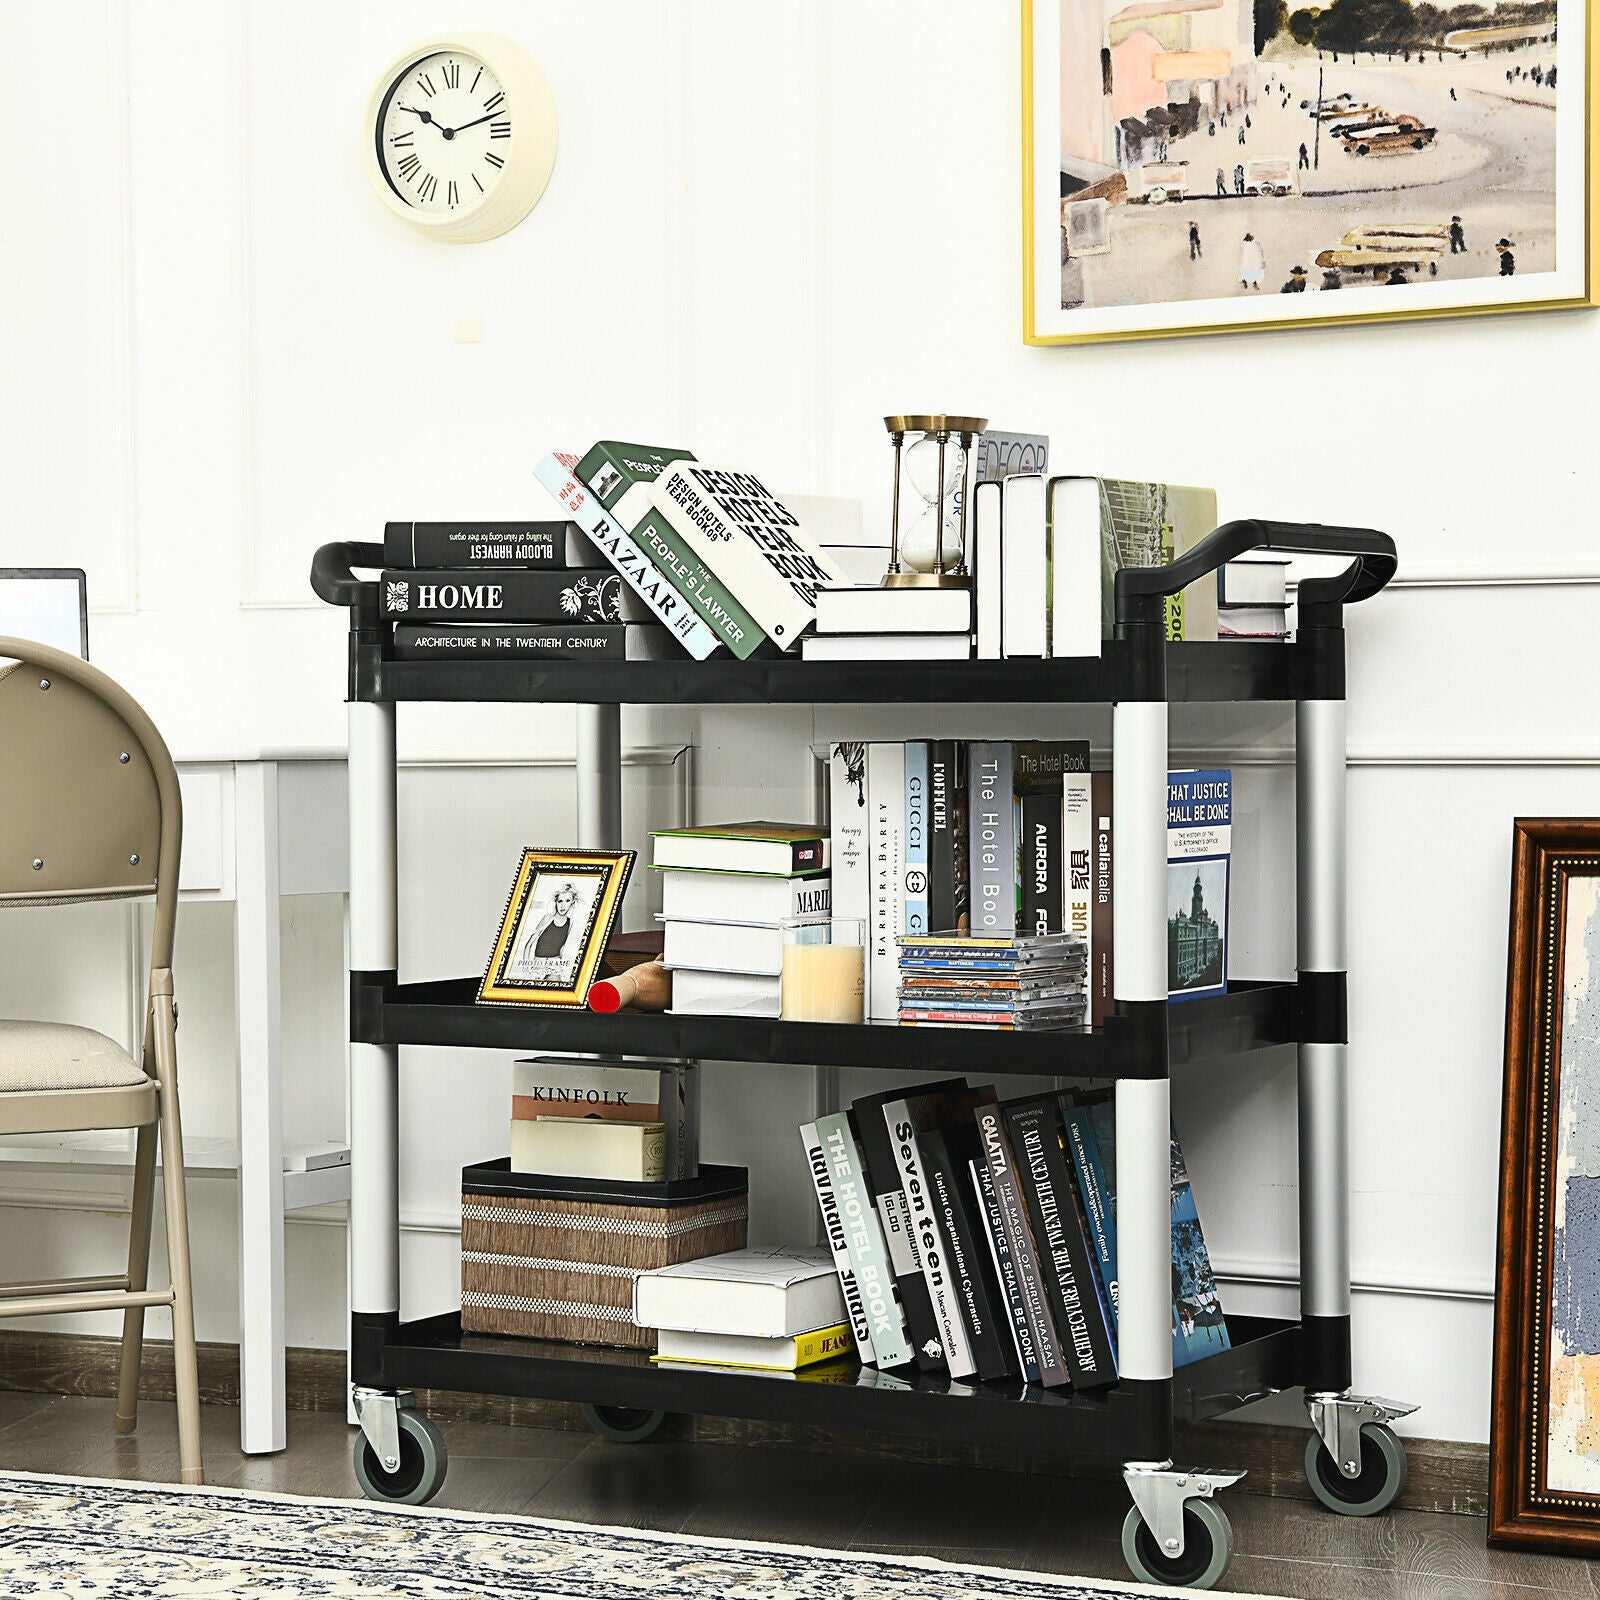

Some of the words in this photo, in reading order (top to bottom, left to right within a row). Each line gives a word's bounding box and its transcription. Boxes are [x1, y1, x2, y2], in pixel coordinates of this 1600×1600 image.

[664, 482, 692, 508] YEAR
[689, 467, 774, 499] DESIGN
[671, 472, 705, 509] DESIGN
[700, 505, 734, 543] HOTELS
[712, 496, 800, 528] HOTELS
[449, 532, 466, 540] organs
[468, 534, 480, 542] their
[489, 532, 503, 542] Gong
[519, 534, 524, 542] of
[543, 534, 552, 542] The
[736, 524, 804, 553] YEAR
[470, 545, 512, 559] HARVEST
[515, 545, 552, 559] BLOODY
[763, 552, 833, 582] BOOK
[590, 518, 677, 618] BAZAAR
[696, 562, 712, 583] THE
[417, 585, 504, 610] HOME
[641, 524, 698, 592] PEOPLE'S
[697, 586, 746, 645] LAWYER
[414, 637, 477, 648] ARCHITECTURE
[481, 637, 491, 648] IN
[495, 637, 511, 648] THE
[515, 637, 562, 648] TWENTIETH
[566, 637, 608, 648] CENTURY
[1021, 754, 1037, 772] The
[1039, 754, 1062, 772] Hotel
[1063, 753, 1086, 771] Book
[981, 760, 998, 801] The
[1191, 782, 1229, 800] JUSTICE
[909, 776, 921, 850] GUCCI
[933, 763, 947, 833] L'OFFICIEL
[1194, 804, 1206, 821] BE
[1207, 803, 1229, 820] DONE
[981, 813, 1000, 872] Hotel
[1035, 823, 1048, 894] AURORA
[532, 1086, 629, 1107] KINFOLK
[980, 1114, 1010, 1177] GALATTA
[1070, 1122, 1080, 1143] 1983
[1023, 1126, 1049, 1182] CENTURY
[1077, 1144, 1087, 1165] since
[935, 1171, 950, 1207] Unicist
[979, 1166, 995, 1198] THAT
[1002, 1182, 1014, 1203] THE
[883, 1194, 901, 1234] IGLOO
[987, 1200, 1010, 1255] JUSTICE
[1008, 1207, 1027, 1250] MAGIC
[1036, 1180, 1066, 1249] TWENTIETH
[825, 1128, 853, 1179] THE
[839, 1180, 874, 1262] HOTEL
[859, 1263, 893, 1337] BOOK
[942, 1207, 970, 1279] Organizational
[1097, 1232, 1110, 1263] Family
[1020, 1253, 1032, 1271] OF
[1052, 1246, 1072, 1275] THE
[1002, 1261, 1021, 1305] SHALL
[1025, 1274, 1044, 1316] SHRUTI
[1058, 1271, 1075, 1288] IN
[962, 1279, 985, 1336] Cybernetics
[1014, 1307, 1026, 1326] BE
[1018, 1328, 1036, 1366] DONE
[1036, 1319, 1057, 1369] HAASAN
